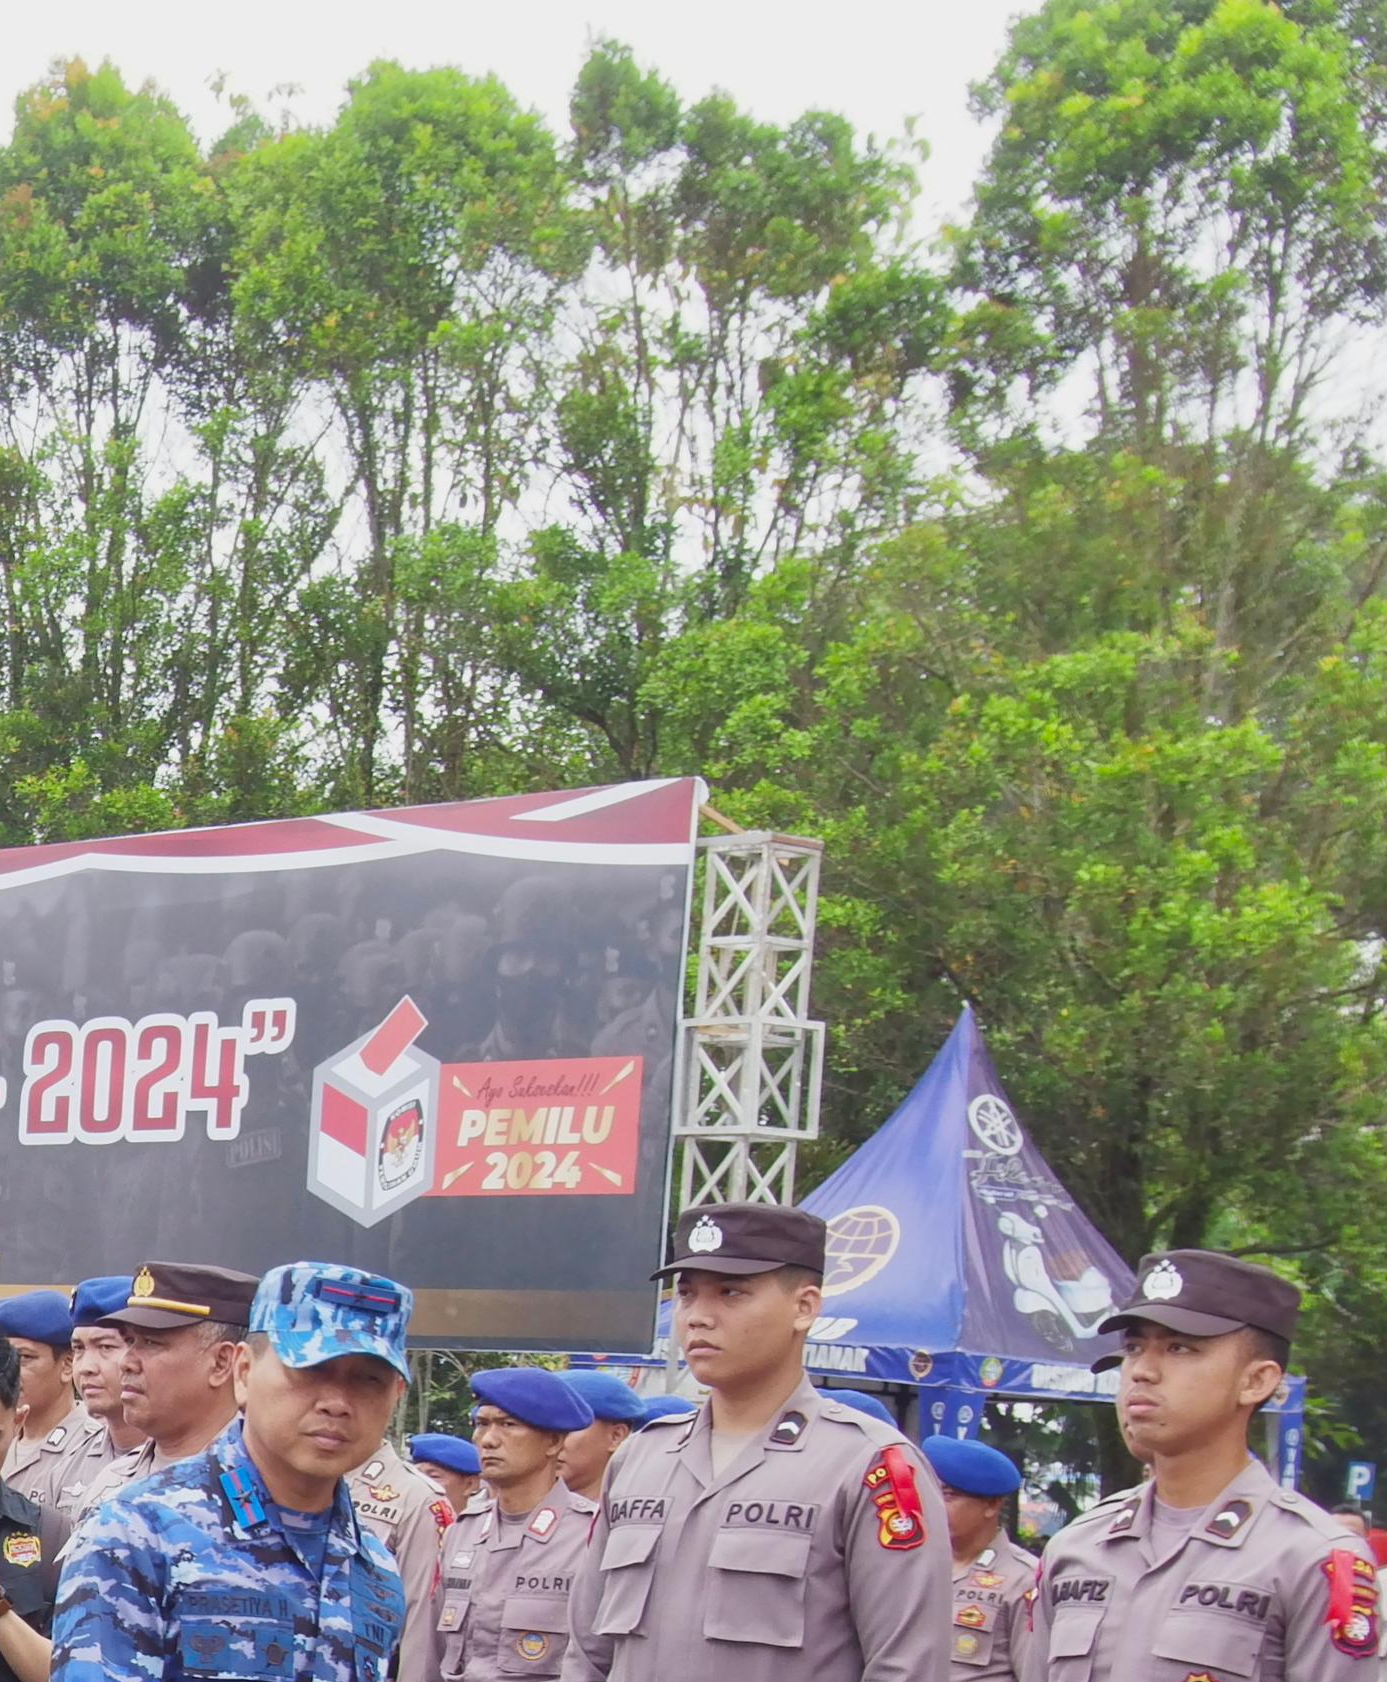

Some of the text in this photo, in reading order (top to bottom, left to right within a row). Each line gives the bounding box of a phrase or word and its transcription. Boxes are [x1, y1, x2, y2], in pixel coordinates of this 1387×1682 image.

[457, 1106, 616, 1147] PEMILU
[481, 1151, 583, 1190] 2024
[1347, 1465, 1371, 1498] P
[725, 1502, 814, 1529] POLRI
[514, 1576, 572, 1592] POLRI
[956, 1588, 1005, 1605] POLRI
[1179, 1584, 1272, 1619] POLRI
